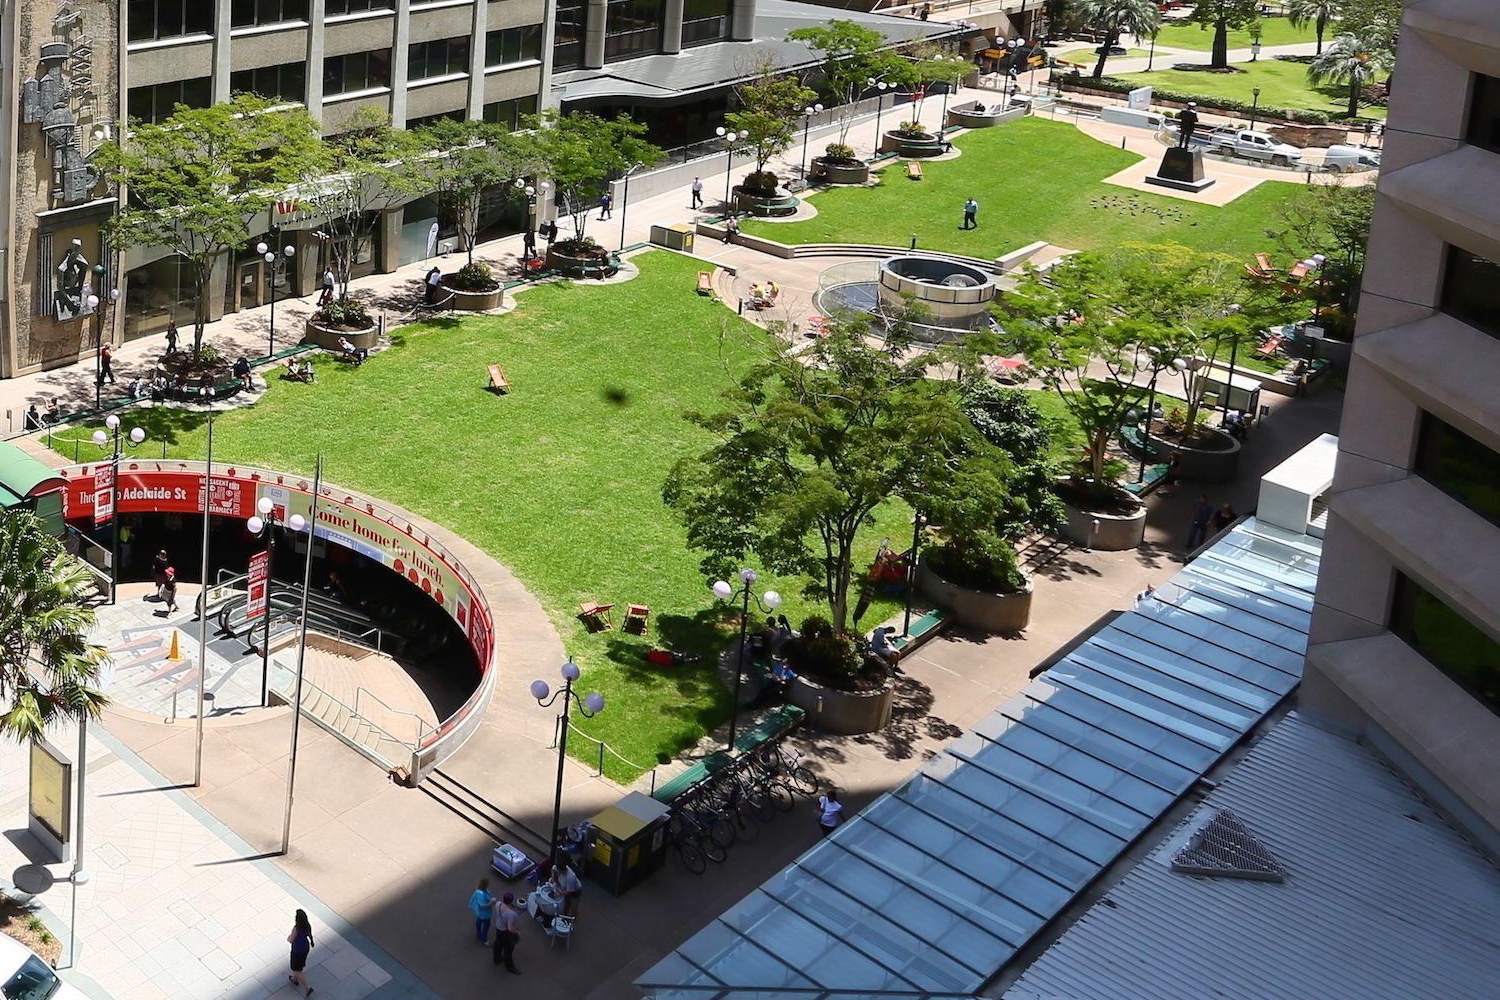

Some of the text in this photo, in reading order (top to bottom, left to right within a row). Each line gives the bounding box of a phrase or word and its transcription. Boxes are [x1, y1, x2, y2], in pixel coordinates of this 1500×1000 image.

[123, 487, 171, 500] Adelaide
[174, 488, 187, 500] St
[352, 518, 391, 547] home
[392, 538, 411, 558] for
